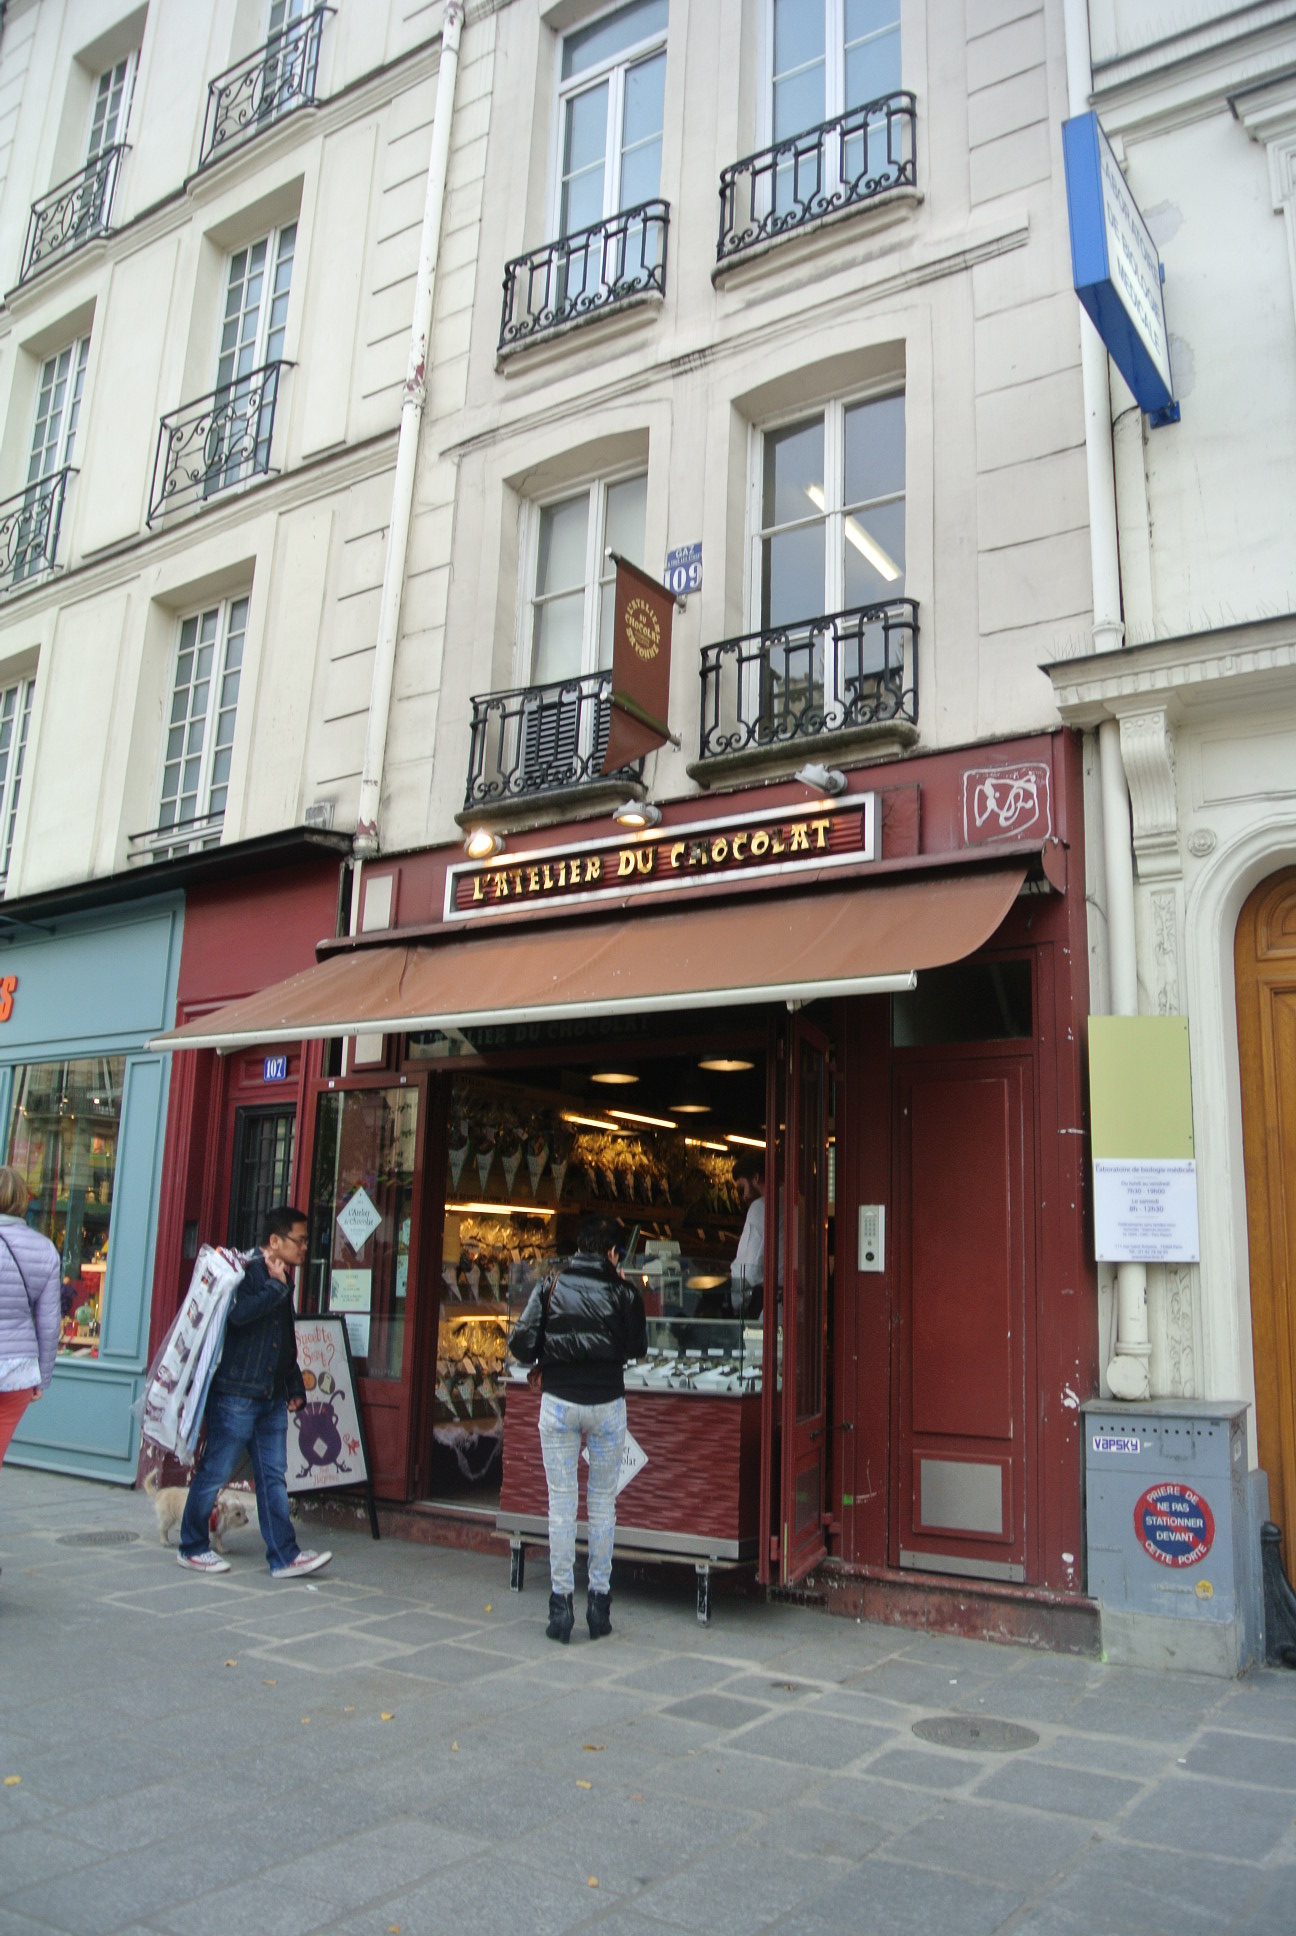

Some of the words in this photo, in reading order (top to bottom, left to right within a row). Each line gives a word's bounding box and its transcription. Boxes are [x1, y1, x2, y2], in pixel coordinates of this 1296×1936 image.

[676, 544, 695, 559] GAZ
[664, 562, 702, 593] 109
[625, 613, 661, 645] CHOCOLAT
[472, 856, 600, 901] L'ATELIER
[617, 847, 654, 876] DU
[670, 818, 830, 868] CHOCOLAT
[0, 974, 18, 1023] S
[266, 1058, 283, 1078] 107
[1095, 1164, 1130, 1173] Laboratoire
[1141, 1166, 1165, 1174] biologie
[1146, 1485, 1181, 1503] PRIERE
[1185, 1490, 1200, 1505] DE
[1157, 1502, 1170, 1512] NE
[1172, 1502, 1190, 1513] PAS
[1145, 1515, 1204, 1528] STATIONNER
[1156, 1530, 1195, 1542] DEVANT
[1145, 1540, 1173, 1565] CETTE
[1178, 1543, 1207, 1566] PORTE
